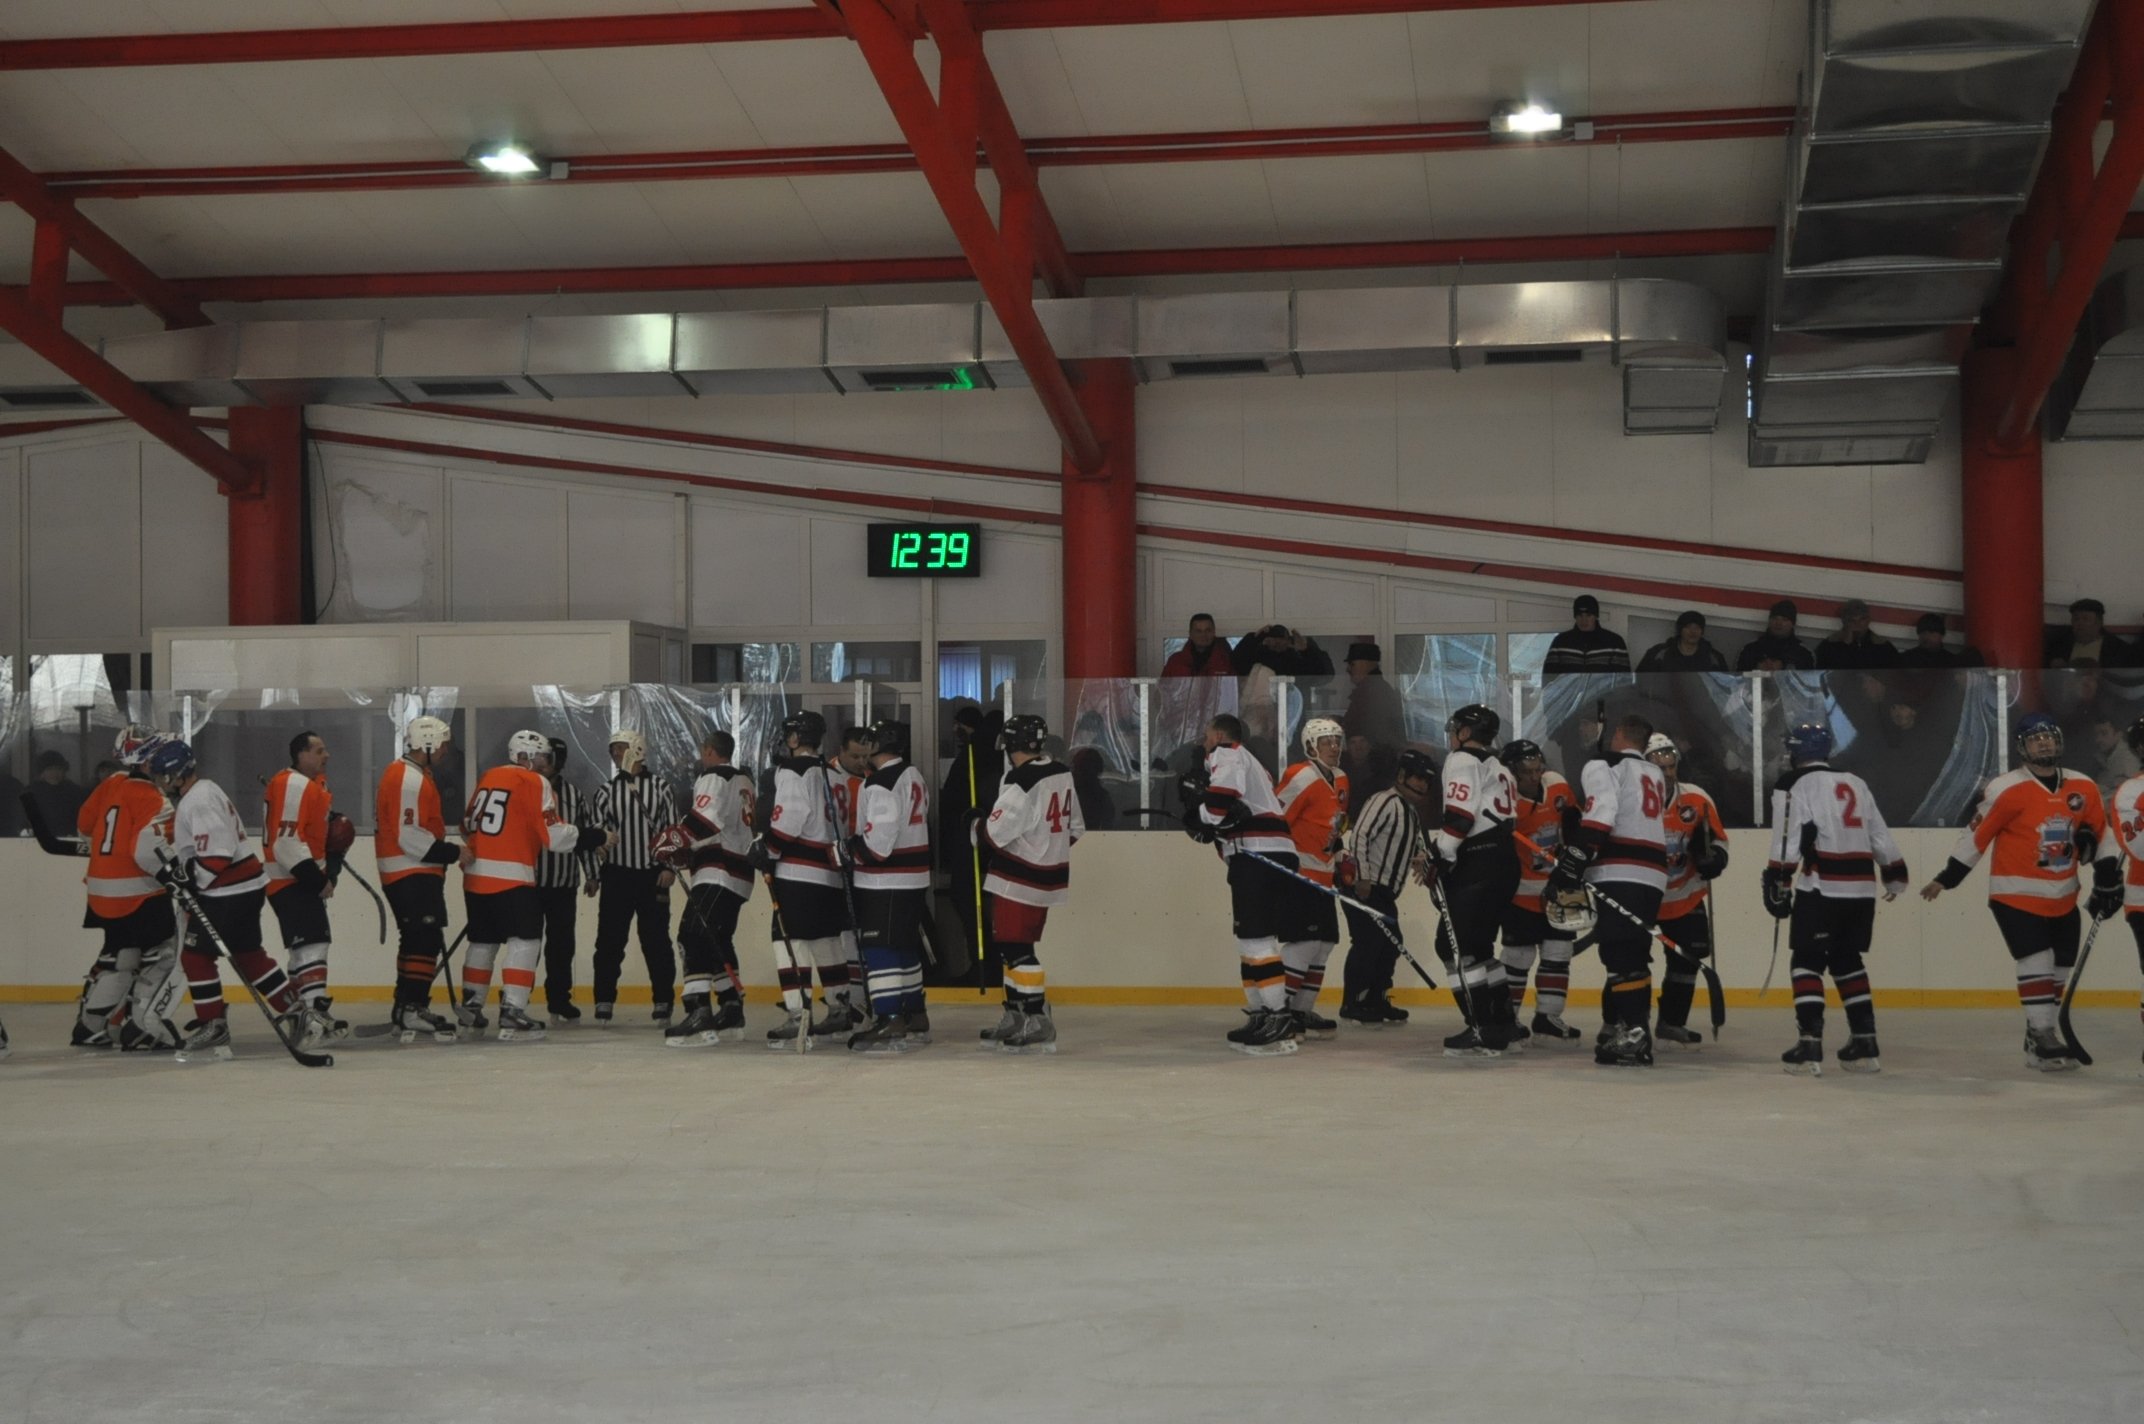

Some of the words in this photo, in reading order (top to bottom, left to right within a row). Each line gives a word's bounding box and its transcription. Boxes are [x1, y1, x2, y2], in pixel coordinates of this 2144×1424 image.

[466, 788, 511, 836] 25
[1046, 789, 1071, 833] 44
[1447, 782, 1470, 801] 35
[1835, 781, 1862, 828] 2
[99, 805, 120, 855] 1
[194, 834, 209, 851] 27
[279, 821, 297, 837] 77
